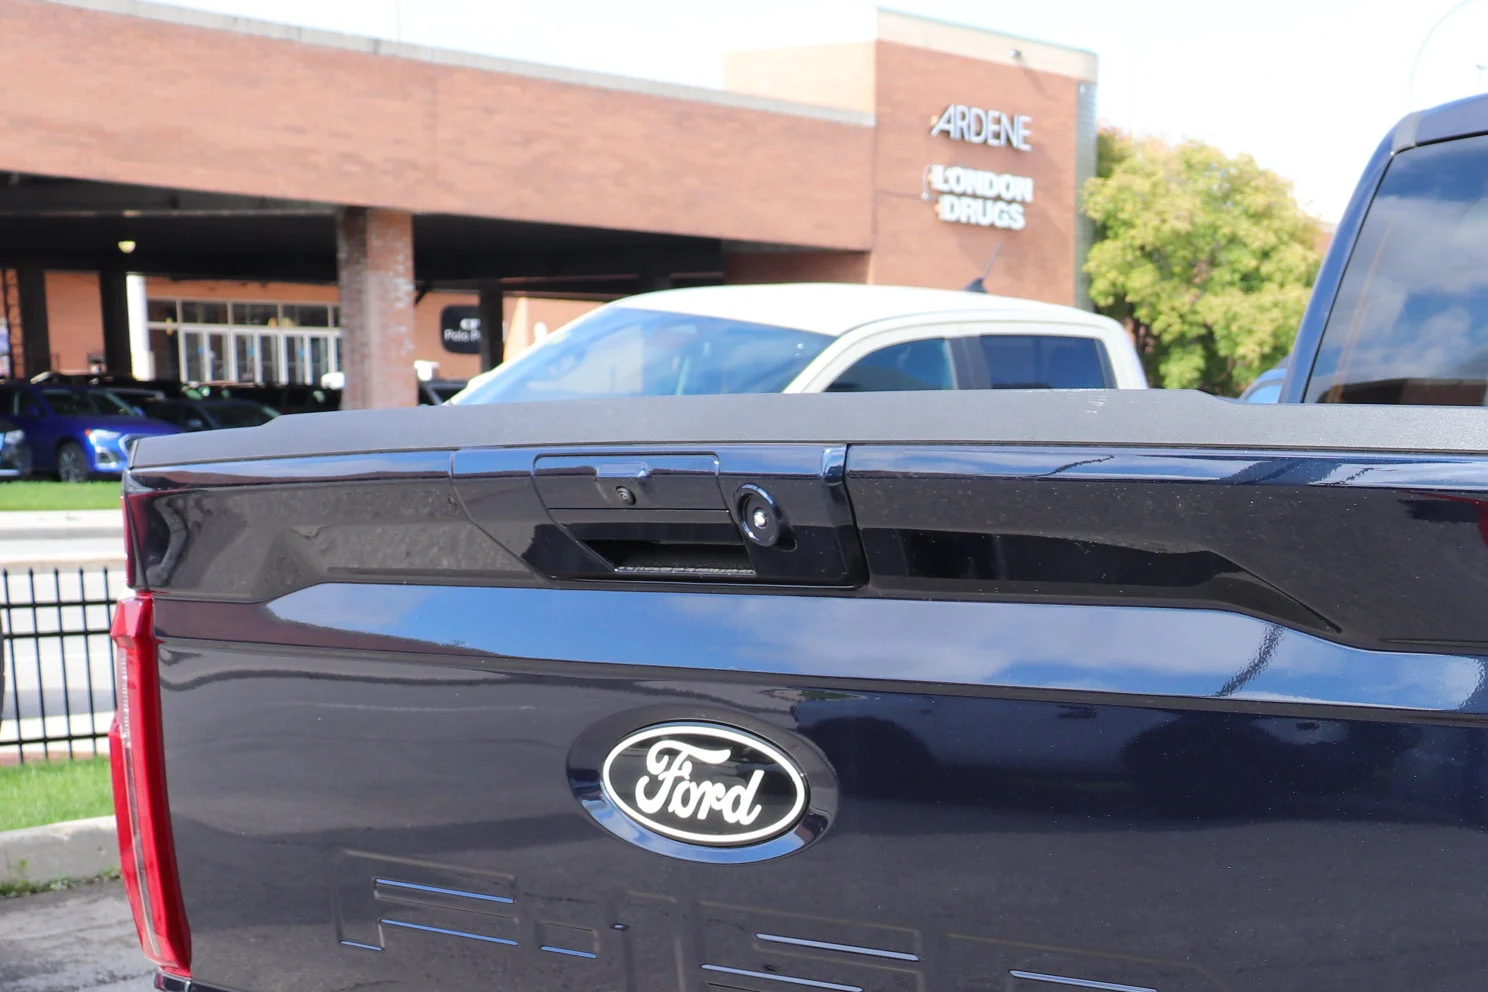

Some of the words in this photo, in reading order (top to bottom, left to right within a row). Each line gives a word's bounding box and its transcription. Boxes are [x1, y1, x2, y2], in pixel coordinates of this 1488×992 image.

[930, 104, 1032, 152] ARDENE
[931, 164, 1034, 203] LONDON
[939, 194, 1025, 230] DRUGS
[635, 740, 765, 825] Ford
